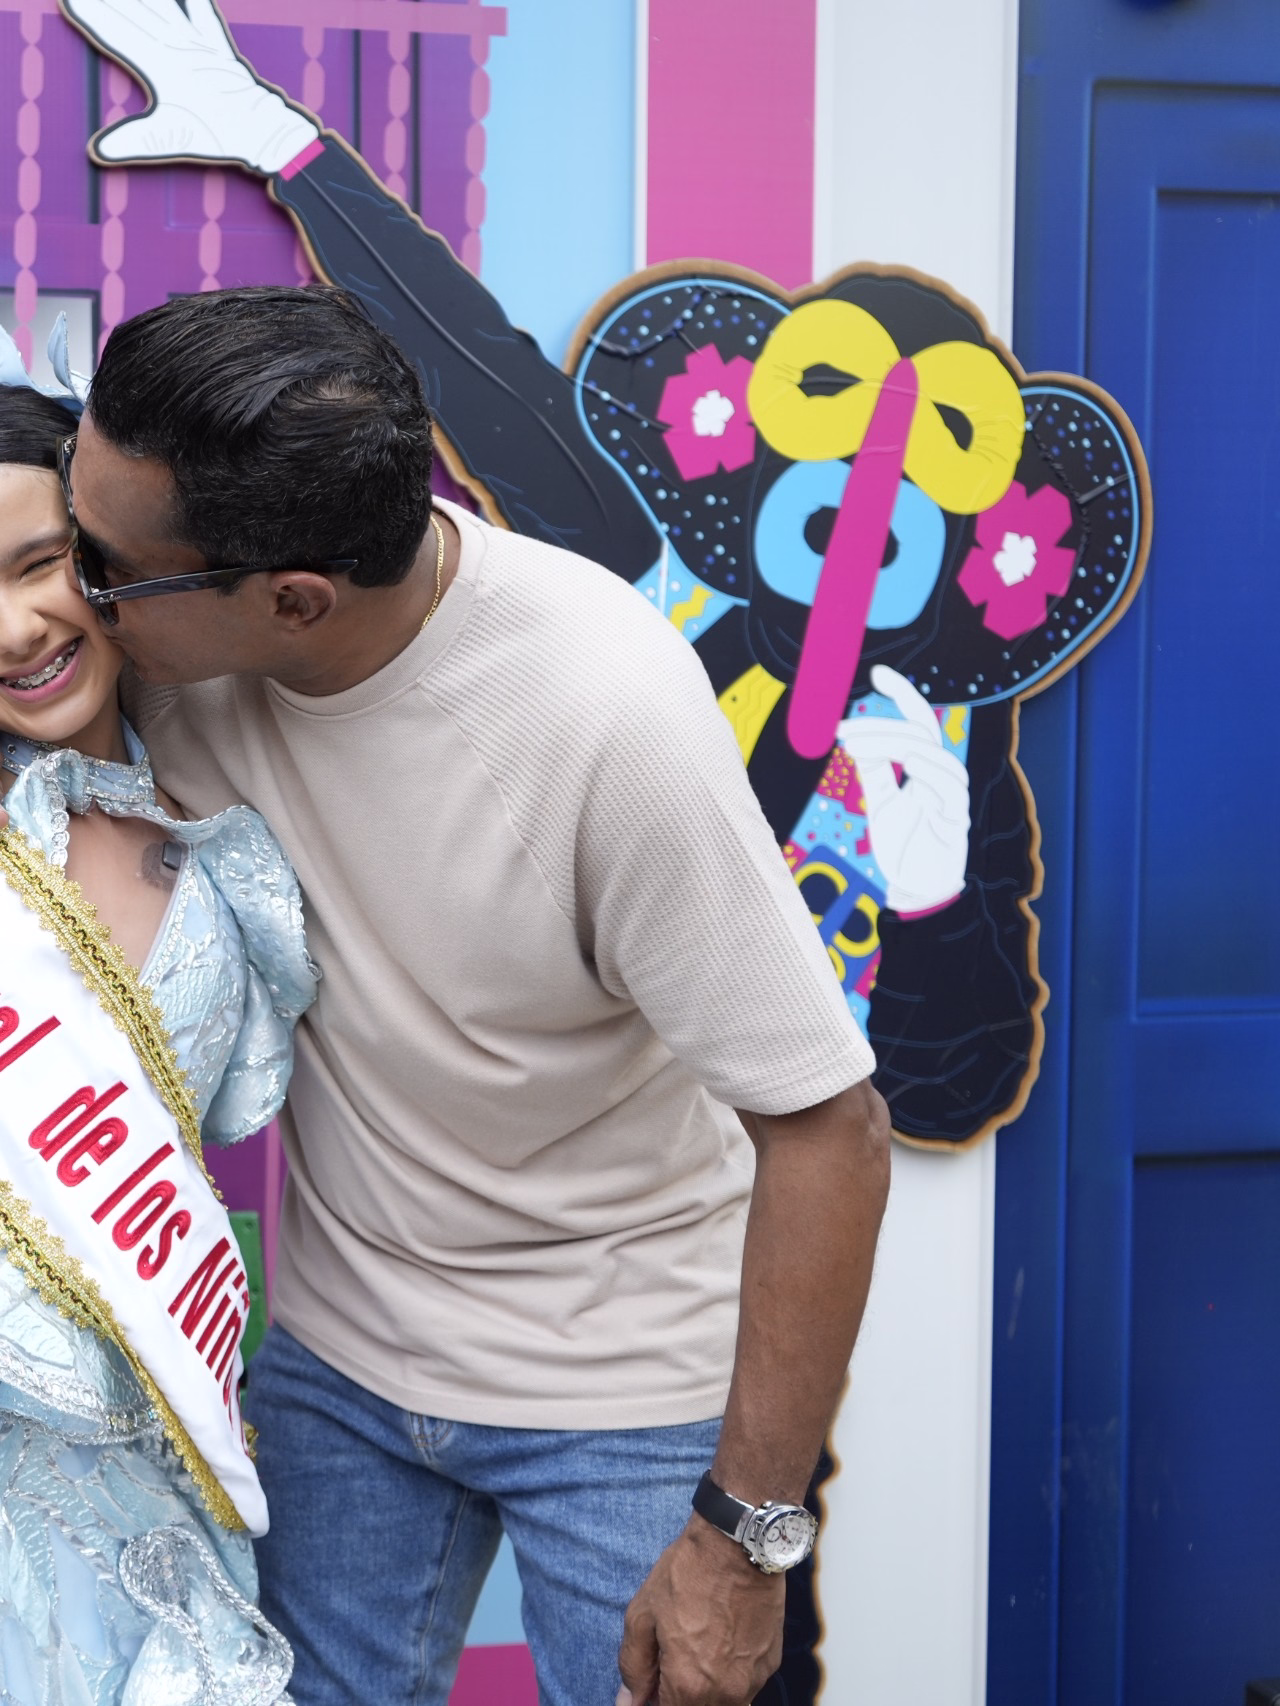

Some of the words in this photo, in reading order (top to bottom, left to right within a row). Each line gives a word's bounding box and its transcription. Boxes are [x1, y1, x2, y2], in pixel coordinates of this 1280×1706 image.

[28, 1081, 129, 1188] de
[91, 1142, 192, 1280] los
[167, 1236, 250, 1456] Niñ
